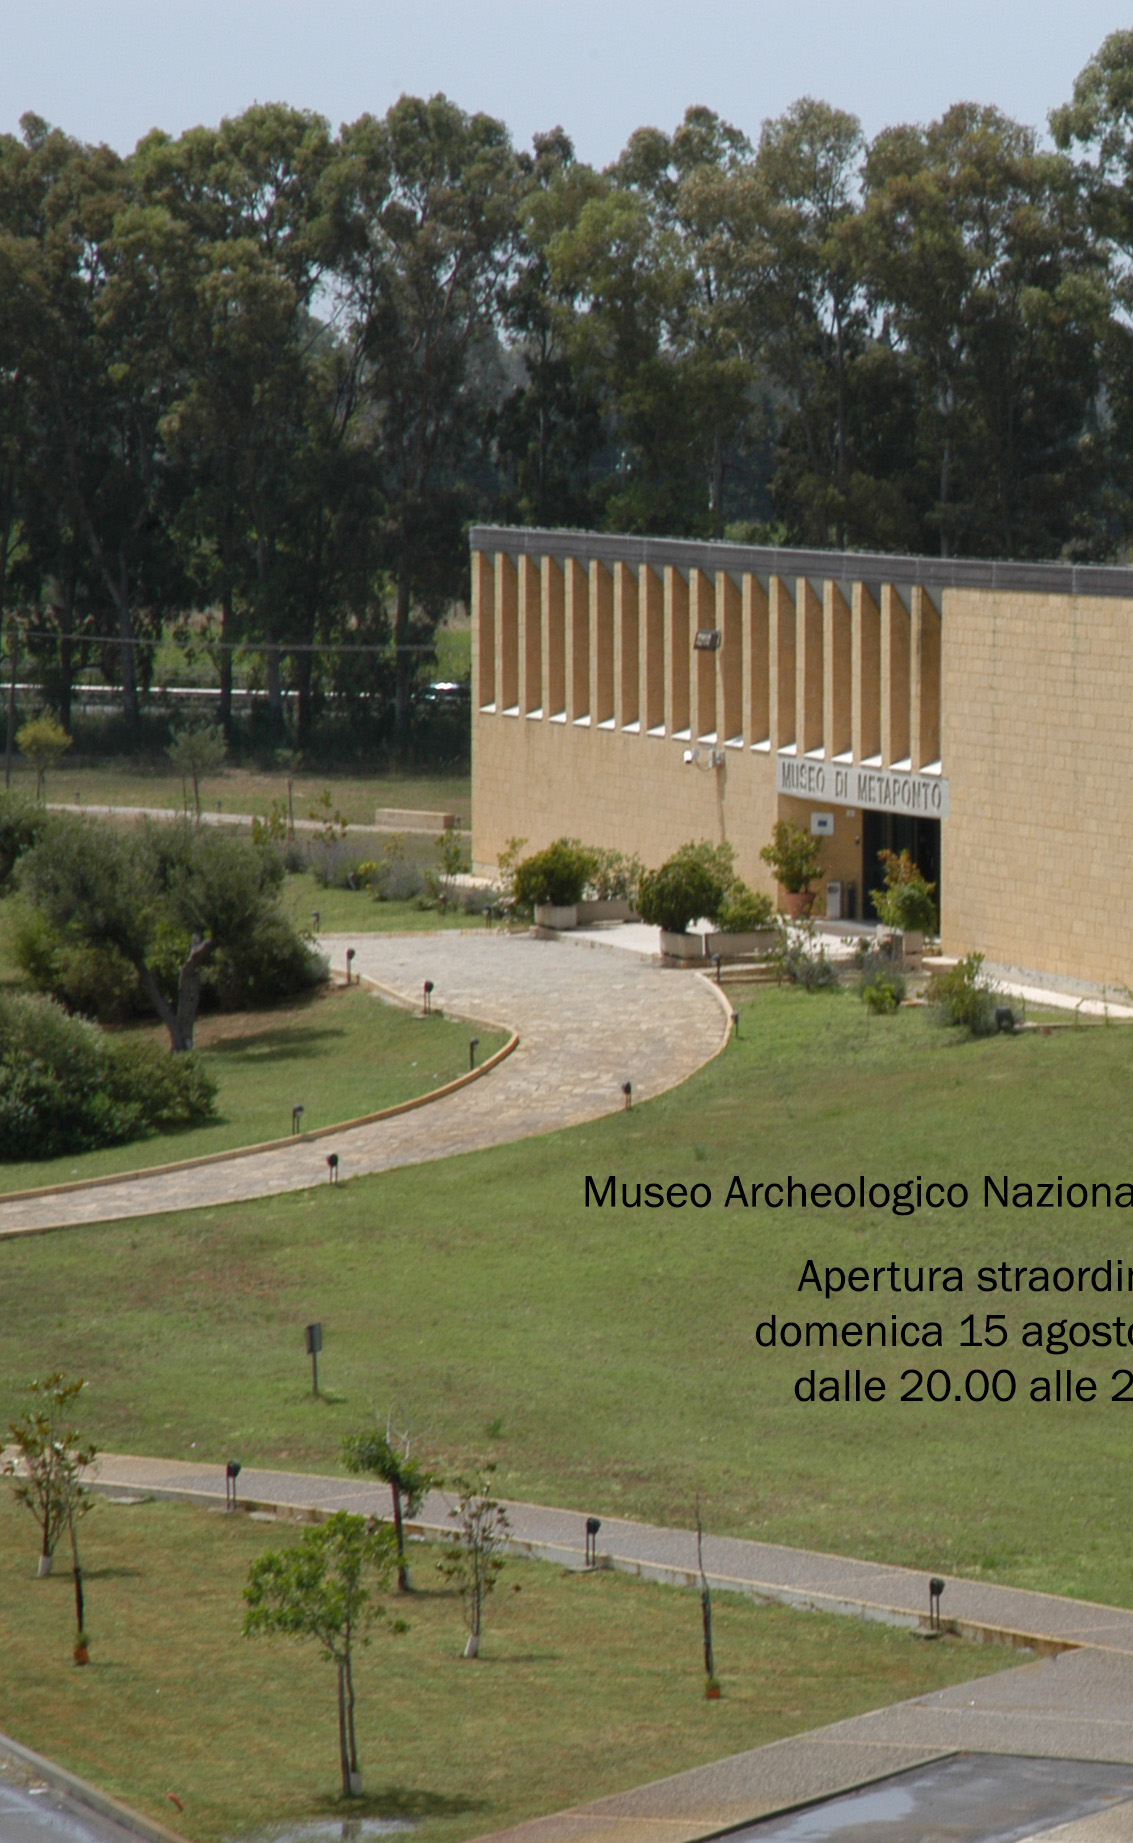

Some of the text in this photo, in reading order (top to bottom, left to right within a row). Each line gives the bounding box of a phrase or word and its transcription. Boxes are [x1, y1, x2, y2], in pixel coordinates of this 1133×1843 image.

[782, 762, 942, 811] MUSEO DI METAPONTO
